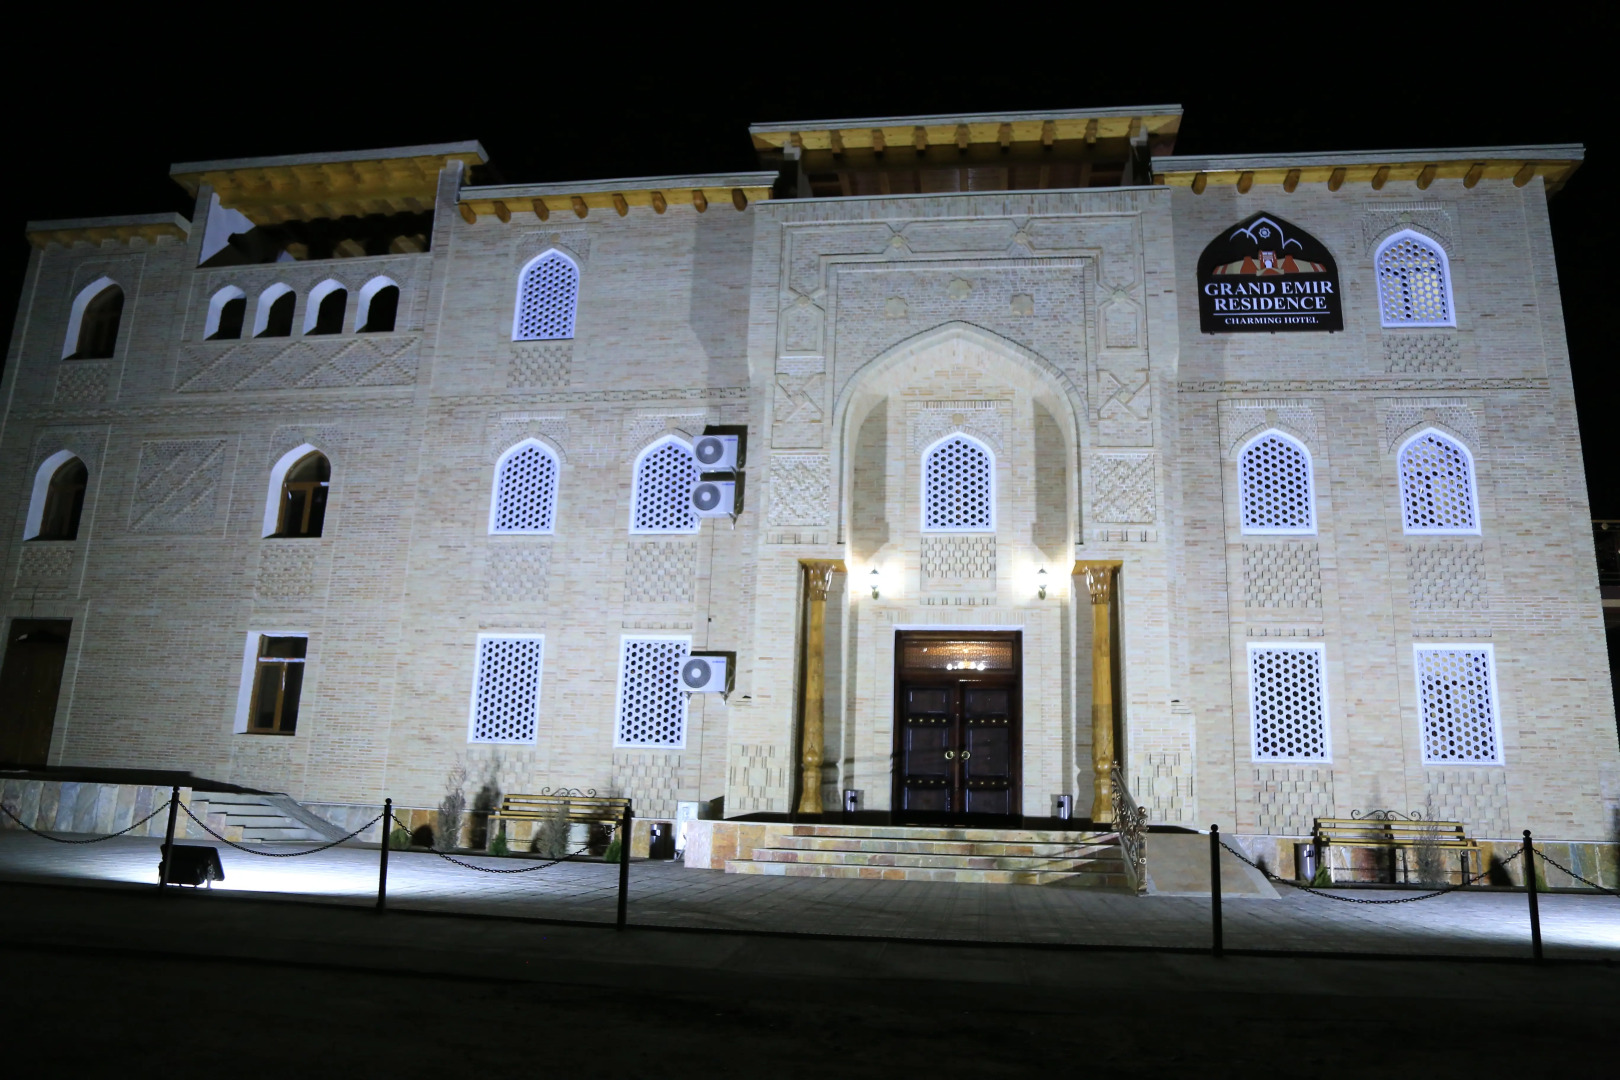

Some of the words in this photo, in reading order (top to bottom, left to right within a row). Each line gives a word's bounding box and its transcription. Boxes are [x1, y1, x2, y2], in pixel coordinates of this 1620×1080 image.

[1204, 282, 1276, 296] GRAND
[1281, 280, 1334, 295] EMIR
[1214, 296, 1327, 311] RESIDENCE
[1224, 317, 1282, 325] CHARMING
[1284, 316, 1319, 324] HOTEL
